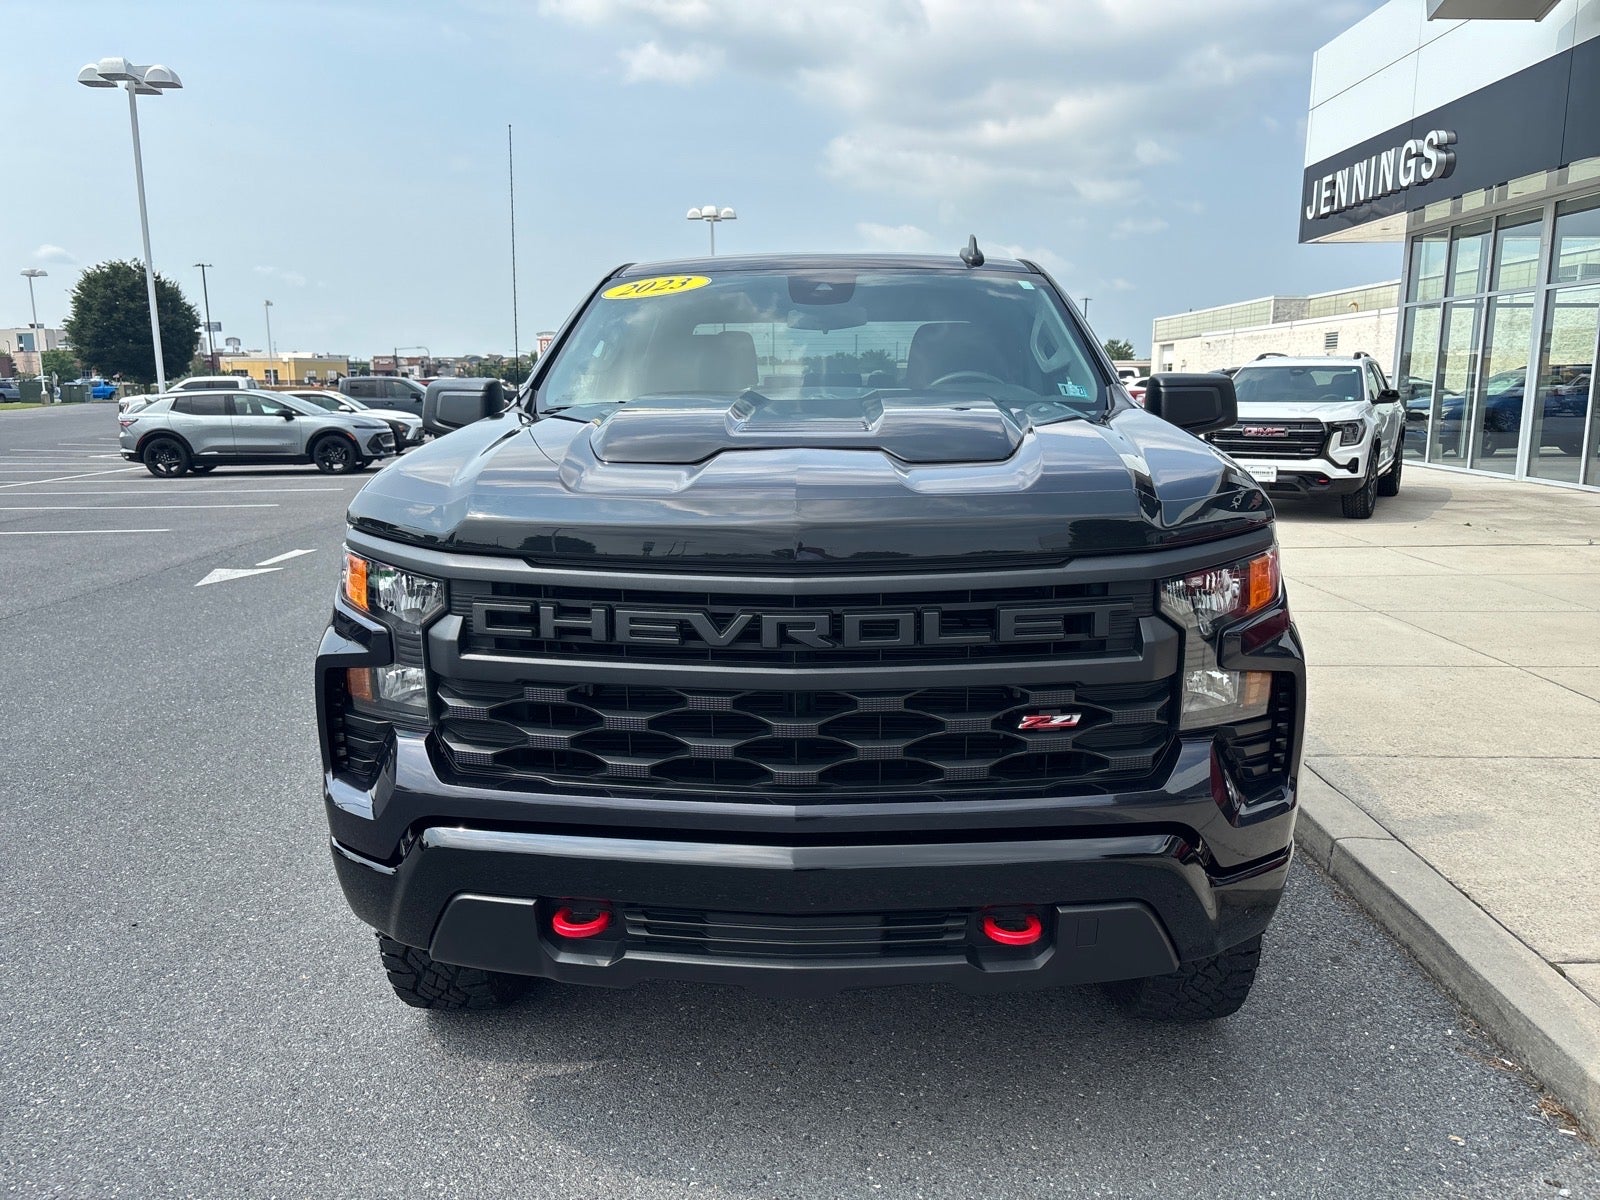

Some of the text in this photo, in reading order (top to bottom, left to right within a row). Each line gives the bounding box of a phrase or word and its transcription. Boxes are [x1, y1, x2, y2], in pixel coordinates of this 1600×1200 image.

[1306, 129, 1452, 220] JENNINGS
[616, 277, 693, 297] 2023
[472, 599, 1135, 650] CHEVROLET
[1018, 714, 1082, 730] Z71
